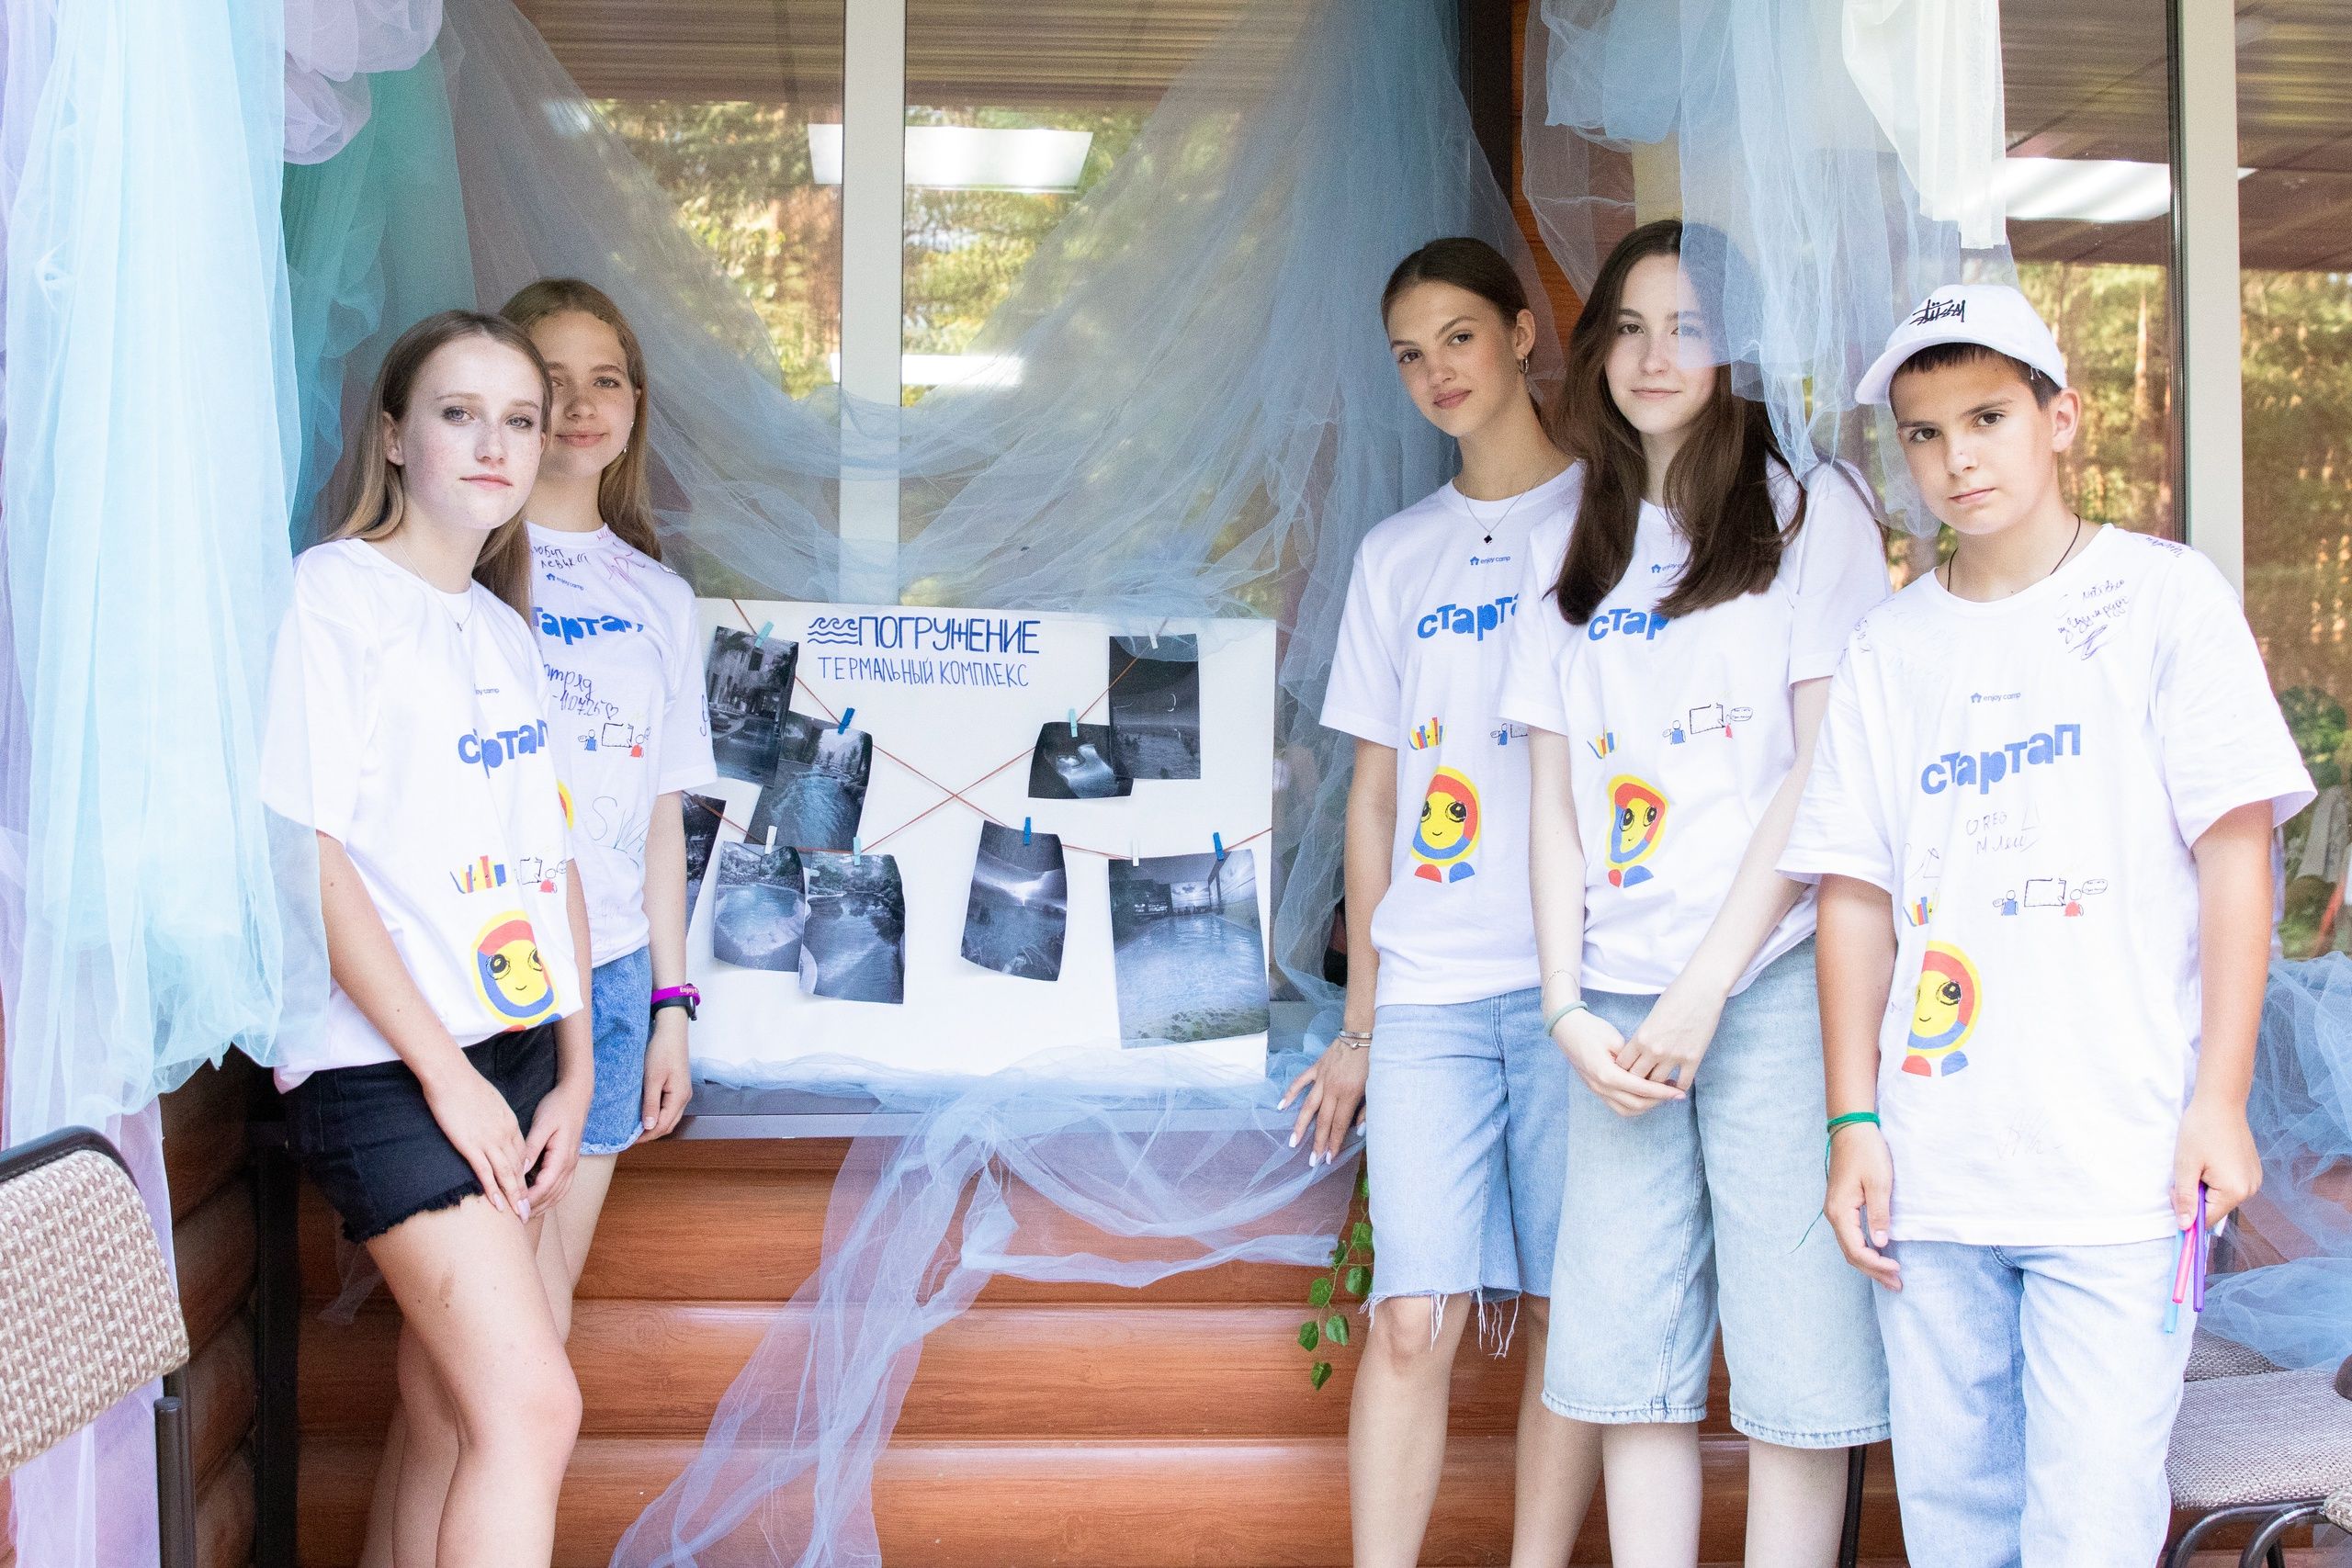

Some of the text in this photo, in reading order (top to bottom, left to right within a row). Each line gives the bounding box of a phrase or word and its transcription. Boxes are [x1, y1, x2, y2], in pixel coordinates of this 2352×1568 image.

[1480, 556, 1495, 564] enjoy
[531, 606, 643, 646] тарта
[858, 615, 1041, 654] ПОГРУЖЕНИЕ
[1417, 592, 1520, 641] старт
[1588, 608, 1670, 641] стар
[818, 657, 1029, 687] ТЕРМАЛЬНЫЙ КОМПЛЕКС
[1983, 692, 2021, 702] enjoy camp
[1920, 724, 2081, 795] стартап
